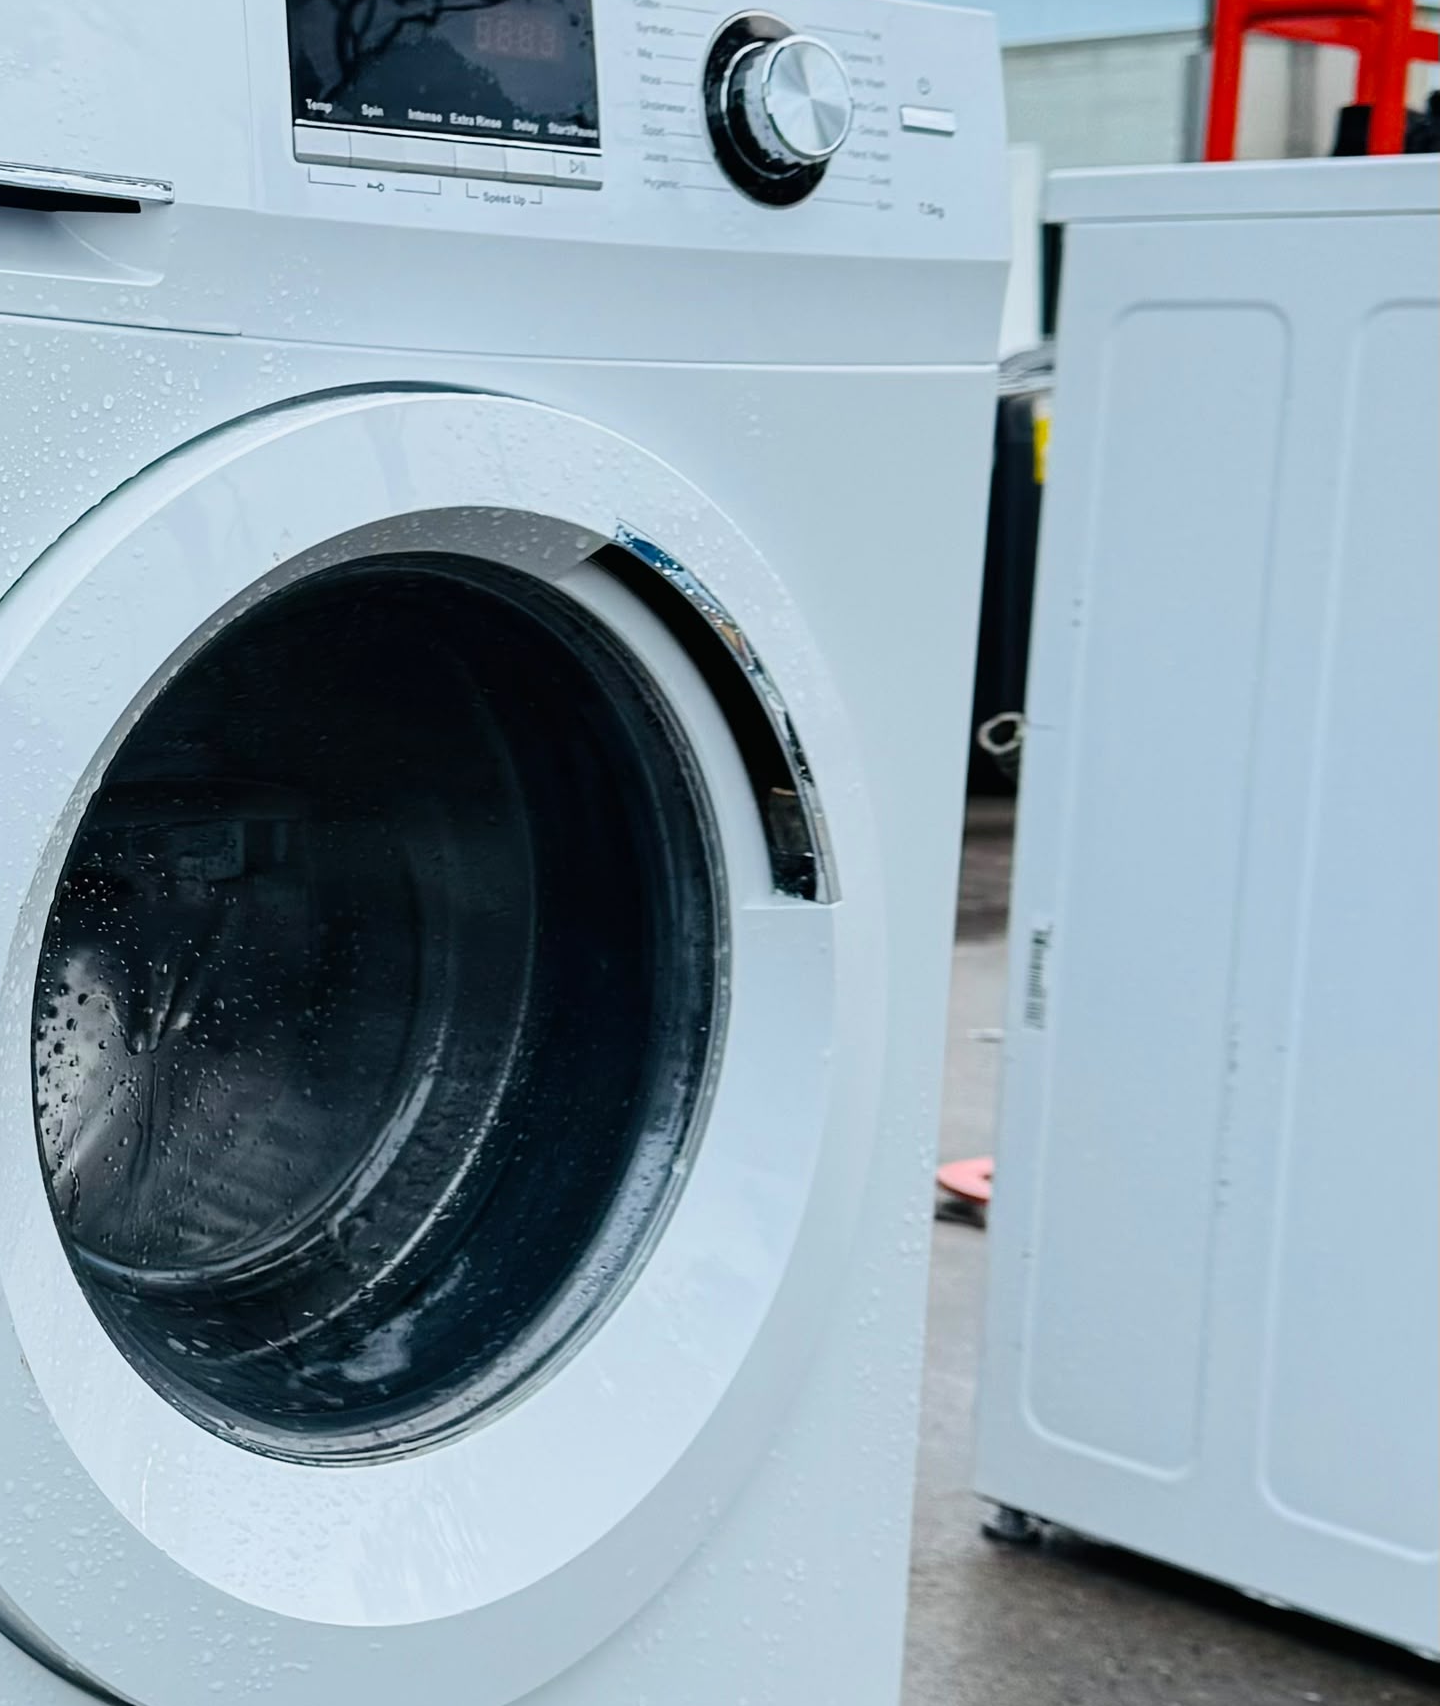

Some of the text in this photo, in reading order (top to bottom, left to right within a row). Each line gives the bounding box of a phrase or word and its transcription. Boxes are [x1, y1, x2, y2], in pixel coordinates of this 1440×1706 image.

[305, 98, 333, 115] Temp
[361, 103, 384, 118] Spin
[408, 108, 443, 123] Intense
[449, 112, 503, 129] Extra Rinse
[512, 119, 539, 135] Delay
[483, 191, 527, 207] Speed Up
